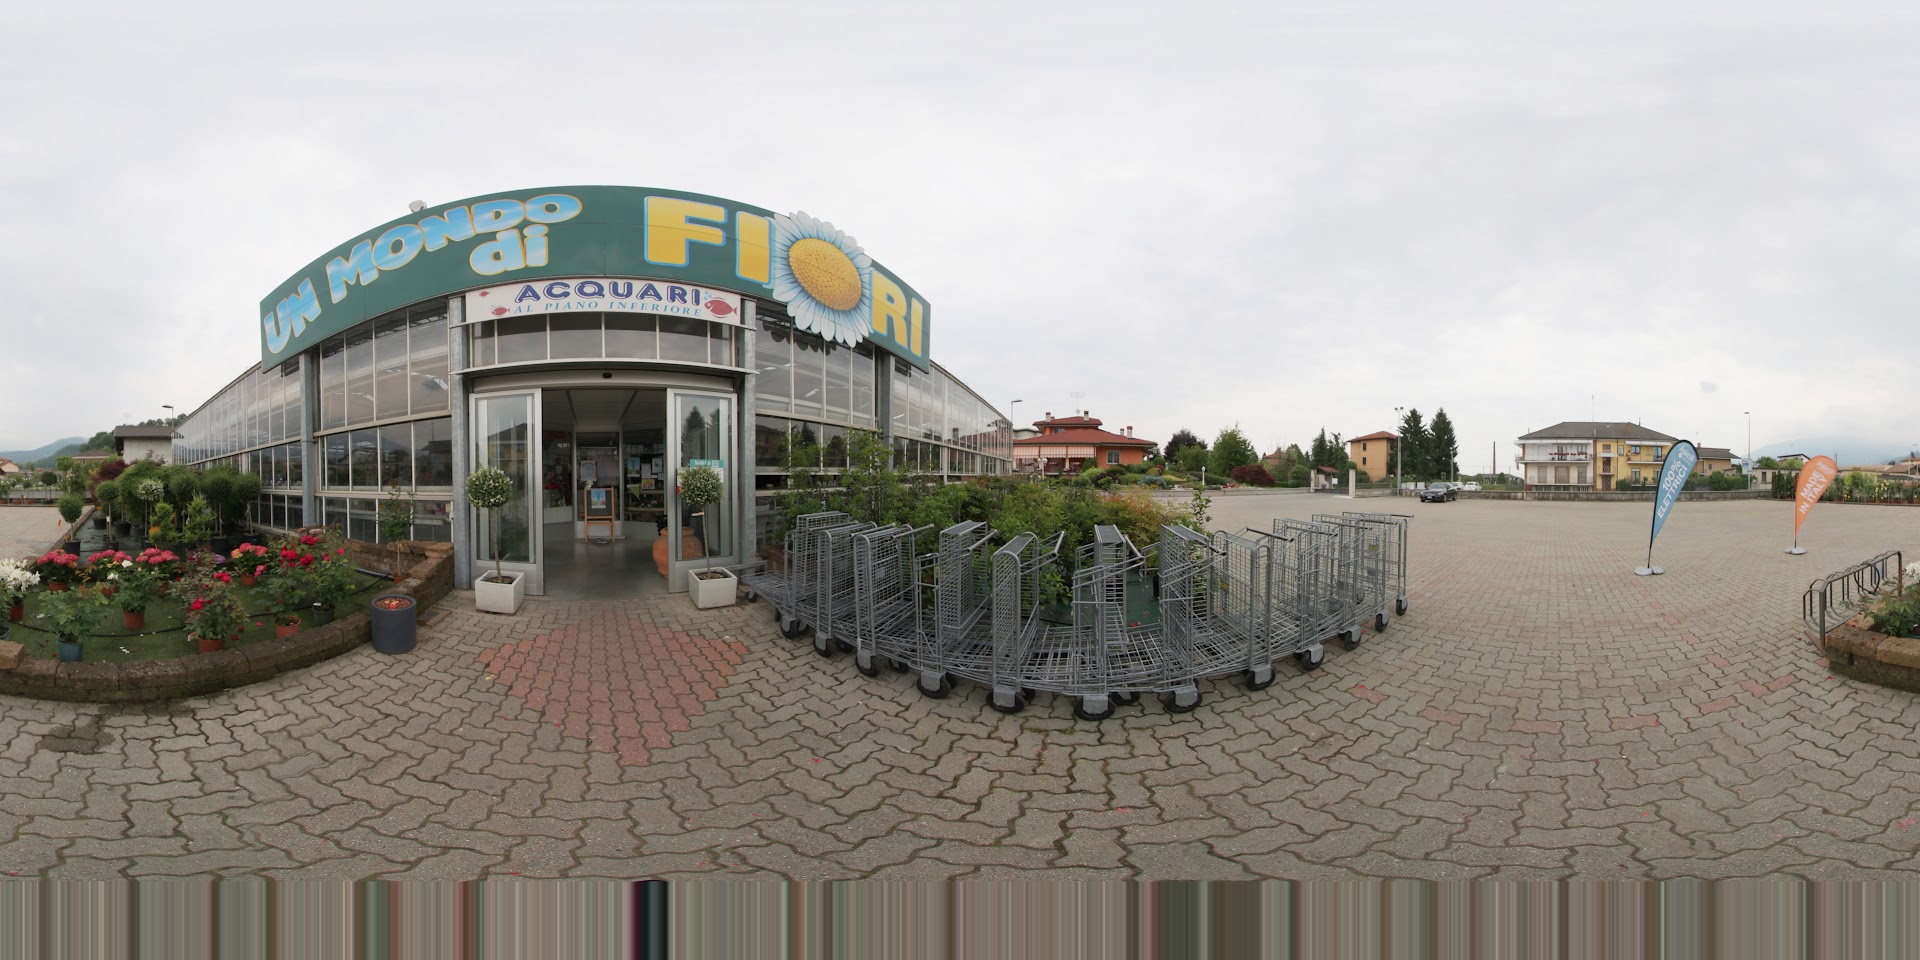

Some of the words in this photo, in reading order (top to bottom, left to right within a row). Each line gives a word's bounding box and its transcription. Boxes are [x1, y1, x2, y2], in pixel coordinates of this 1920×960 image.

[469, 223, 549, 276] di
[263, 277, 322, 354] UN
[325, 193, 583, 304] MONDO
[514, 280, 701, 306] ACQUARI
[644, 195, 925, 358] FIORI
[514, 306, 534, 314] AL
[544, 301, 599, 311] PIANO
[609, 302, 701, 317] INFERIORE
[1657, 464, 1688, 518] ELETTRICI
[1662, 459, 1682, 491] 100%
[1799, 502, 1810, 514] IN
[1807, 473, 1828, 503] ITALY
[1800, 470, 1821, 499] MADE
